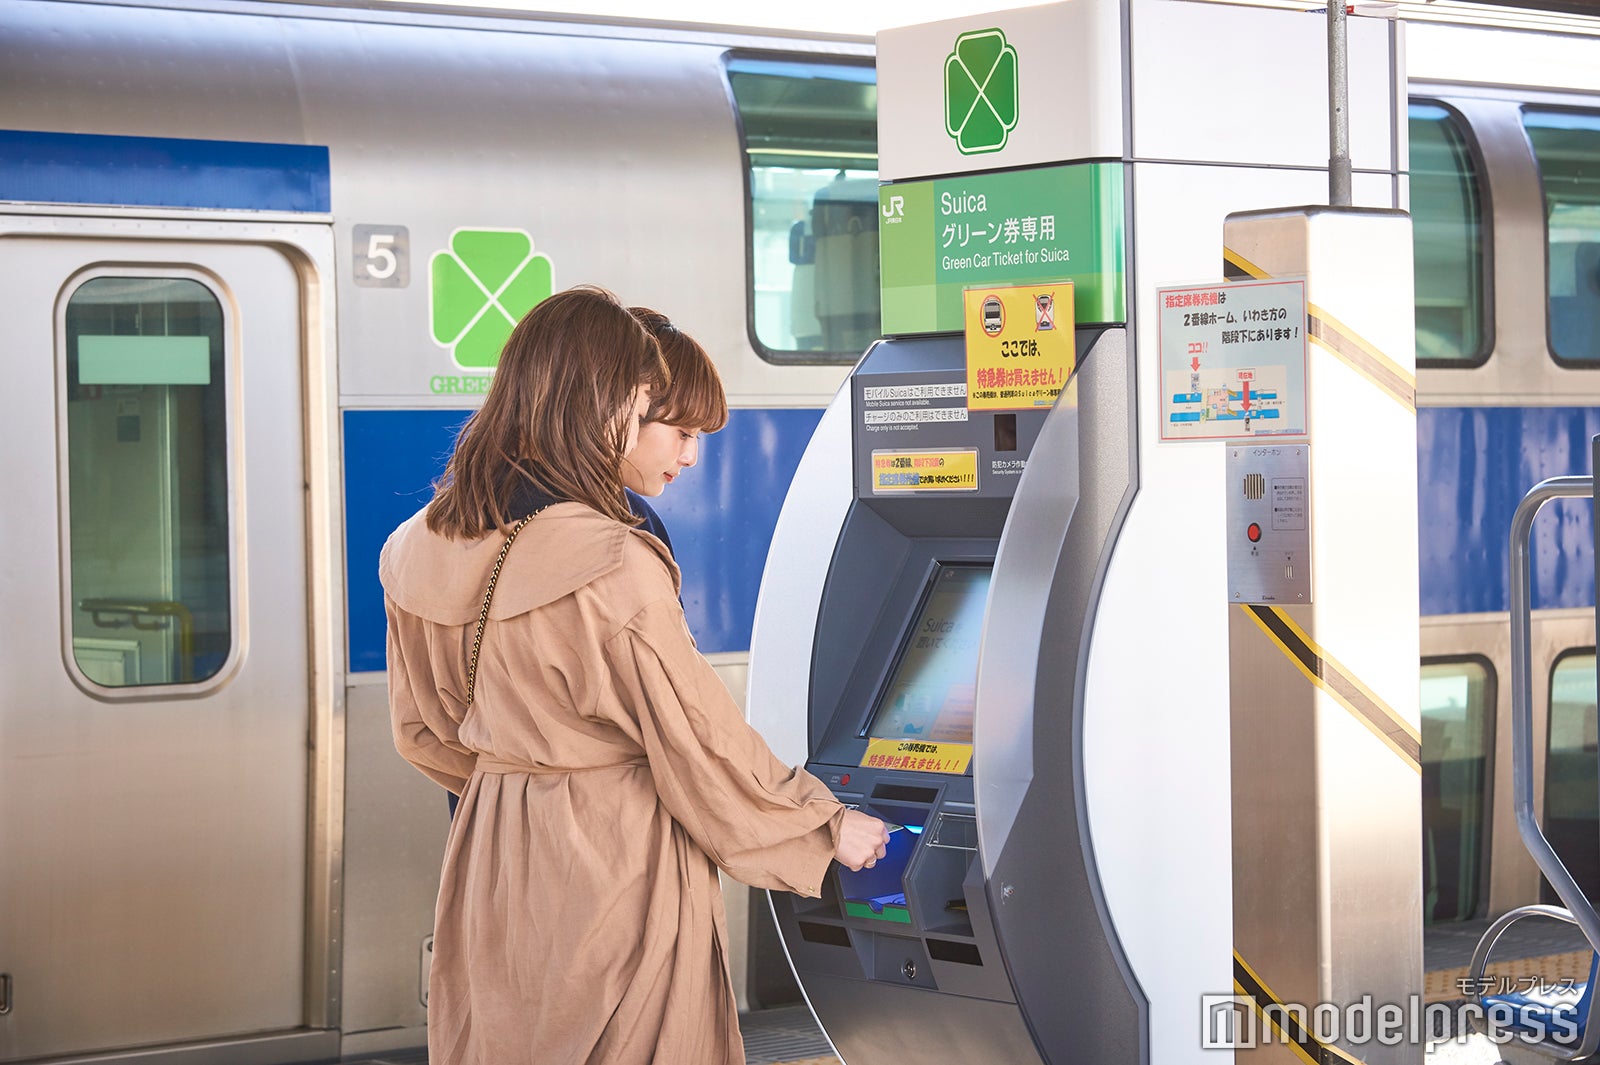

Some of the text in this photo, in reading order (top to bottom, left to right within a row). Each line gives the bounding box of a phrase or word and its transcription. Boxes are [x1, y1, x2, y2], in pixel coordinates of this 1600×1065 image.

[882, 196, 905, 217] JR
[941, 191, 987, 215] Suica
[942, 215, 1055, 248] グリーン券専用
[366, 234, 397, 279] 5
[942, 247, 1070, 270] Green Car Ticket for Suica
[1165, 292, 1226, 309] 指定席券売機は
[1001, 339, 1041, 357] ここでは、
[430, 375, 491, 394] GREE
[866, 386, 966, 399] モバイルSuicaはご利用できません
[866, 410, 966, 423] チャージのみのご利用はできません
[1253, 449, 1281, 457] インターホン
